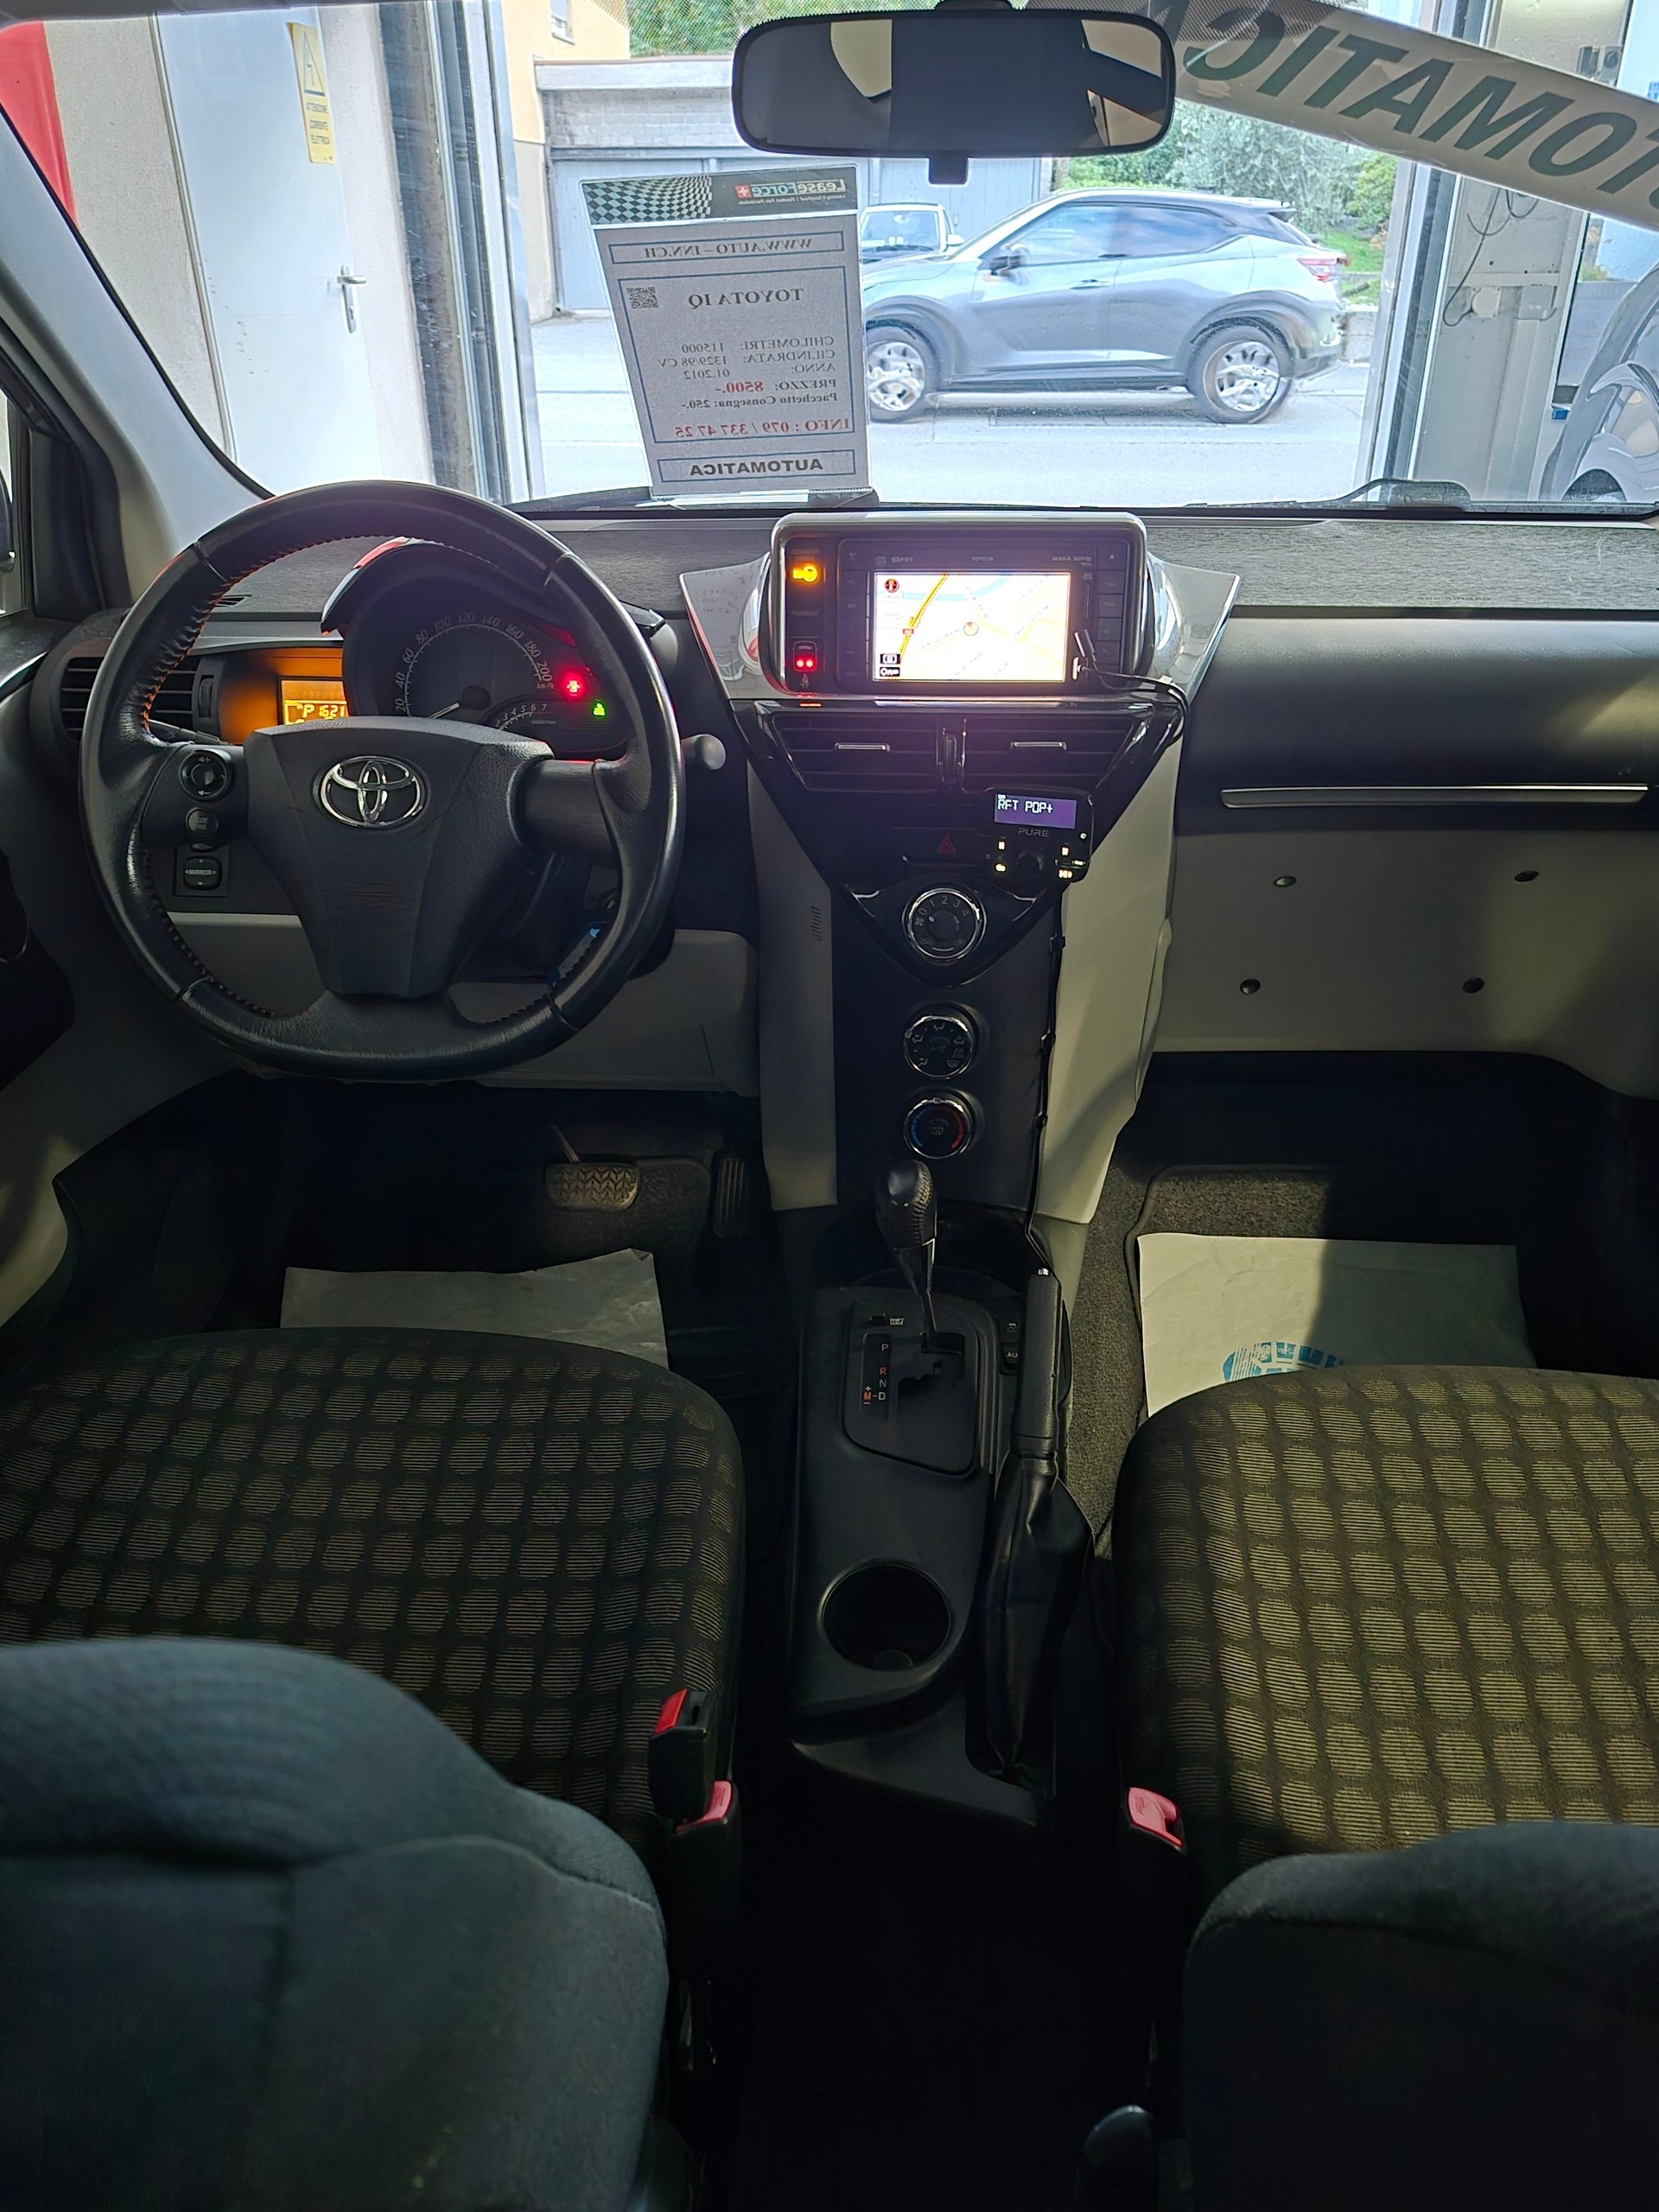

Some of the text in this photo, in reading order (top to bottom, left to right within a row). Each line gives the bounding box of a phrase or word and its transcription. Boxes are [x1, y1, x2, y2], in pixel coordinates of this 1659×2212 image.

[395, 612, 553, 712] 20 40 60 80 100 120 140 160 180 200
[302, 703, 315, 718] P
[504, 713, 509, 721] 3
[511, 705, 517, 715] 4
[520, 704, 526, 713] 5
[531, 703, 537, 712] 6
[541, 703, 548, 712] 7
[1018, 828, 1049, 837] PURE
[941, 895, 949, 905] 2
[952, 899, 961, 908] 3
[880, 1367, 887, 1376] R
[879, 1379, 887, 1388] N
[878, 1391, 886, 1401] D
